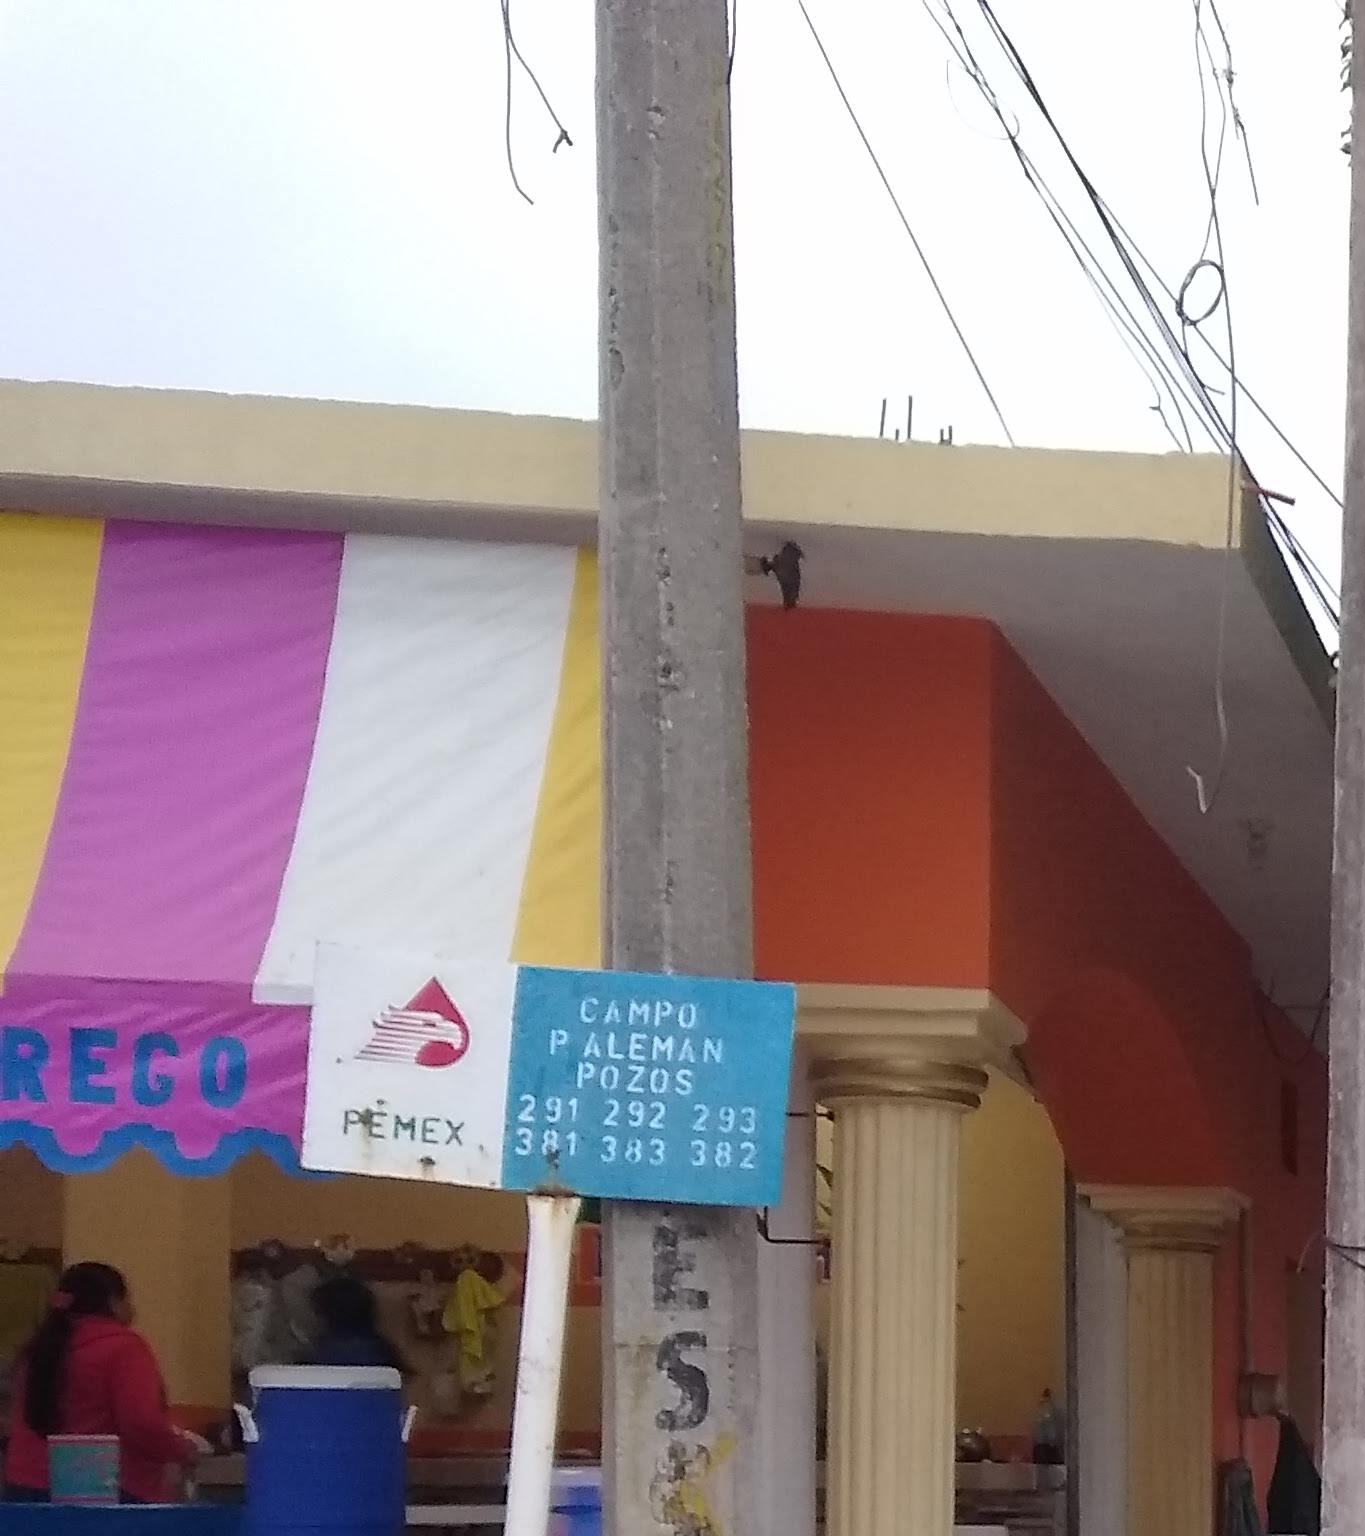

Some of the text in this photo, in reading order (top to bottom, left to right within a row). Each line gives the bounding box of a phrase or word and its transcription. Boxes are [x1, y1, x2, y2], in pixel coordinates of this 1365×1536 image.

[579, 997, 697, 1029] CAMPO
[550, 1030, 723, 1063] P ALEMAN
[576, 1063, 694, 1095] POZOS
[343, 1108, 464, 1146] PEMEX
[517, 1094, 757, 1133] 291 292 293
[515, 1127, 757, 1169] 381 383 382
